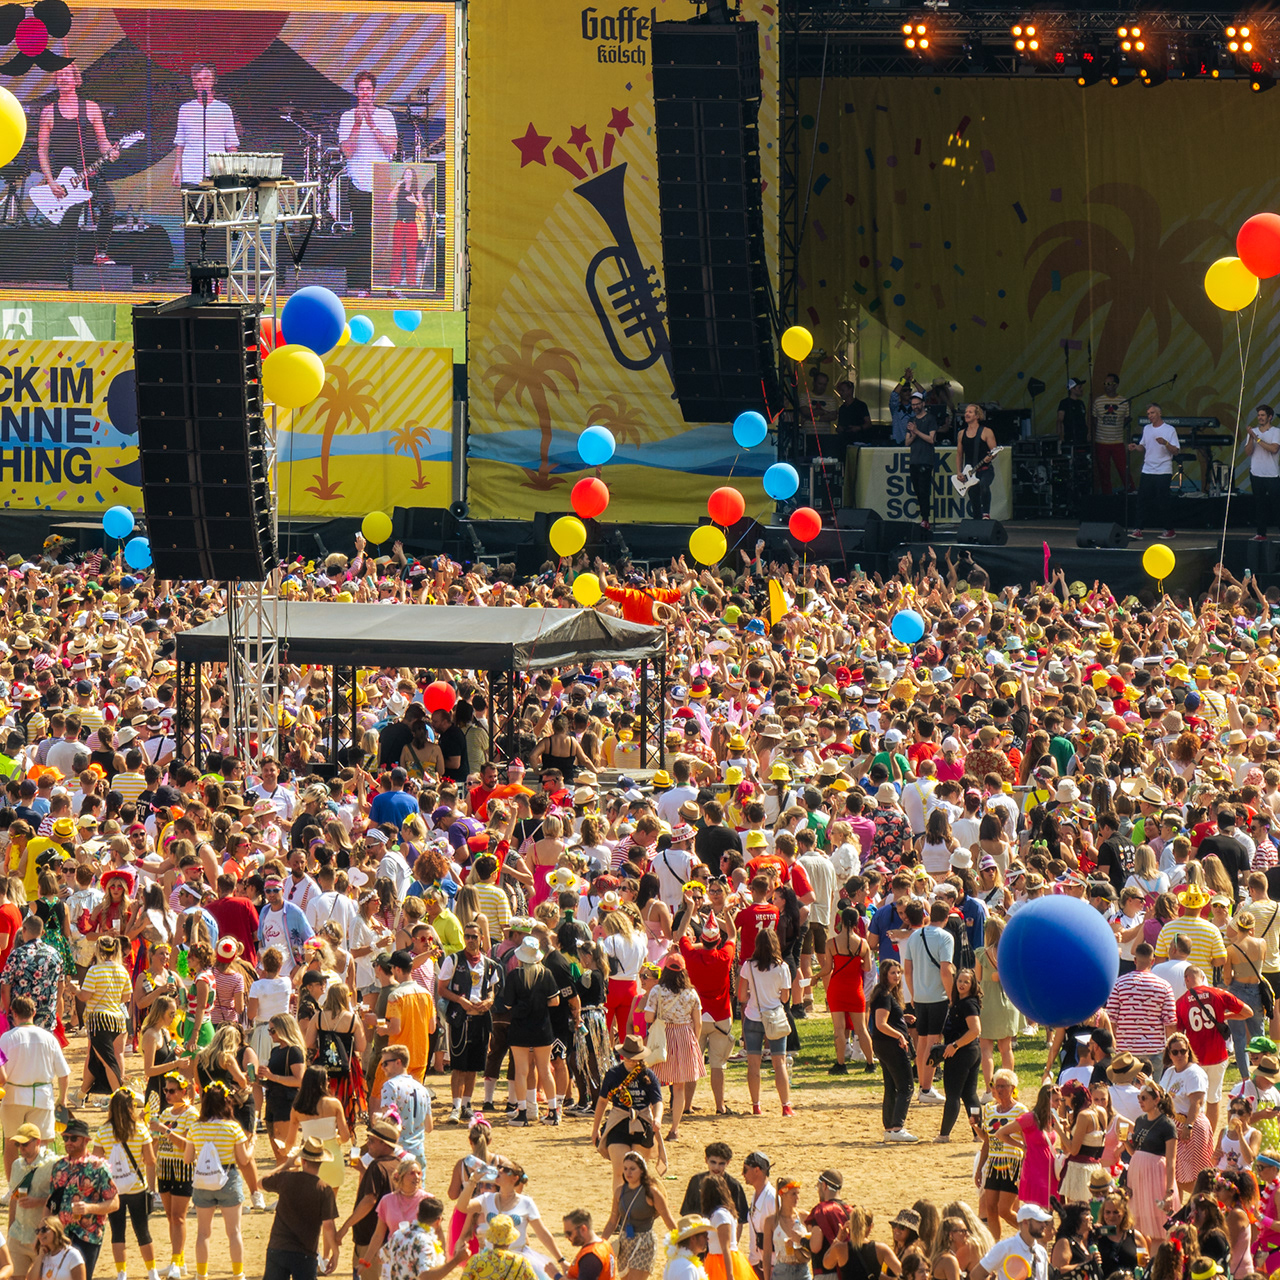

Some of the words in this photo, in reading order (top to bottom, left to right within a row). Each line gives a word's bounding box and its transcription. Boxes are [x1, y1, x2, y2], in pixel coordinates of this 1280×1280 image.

[50, 367, 93, 403] IM
[885, 452, 952, 474] JEK
[755, 913, 777, 921] HECTOR
[1188, 1003, 1216, 1032] 69
